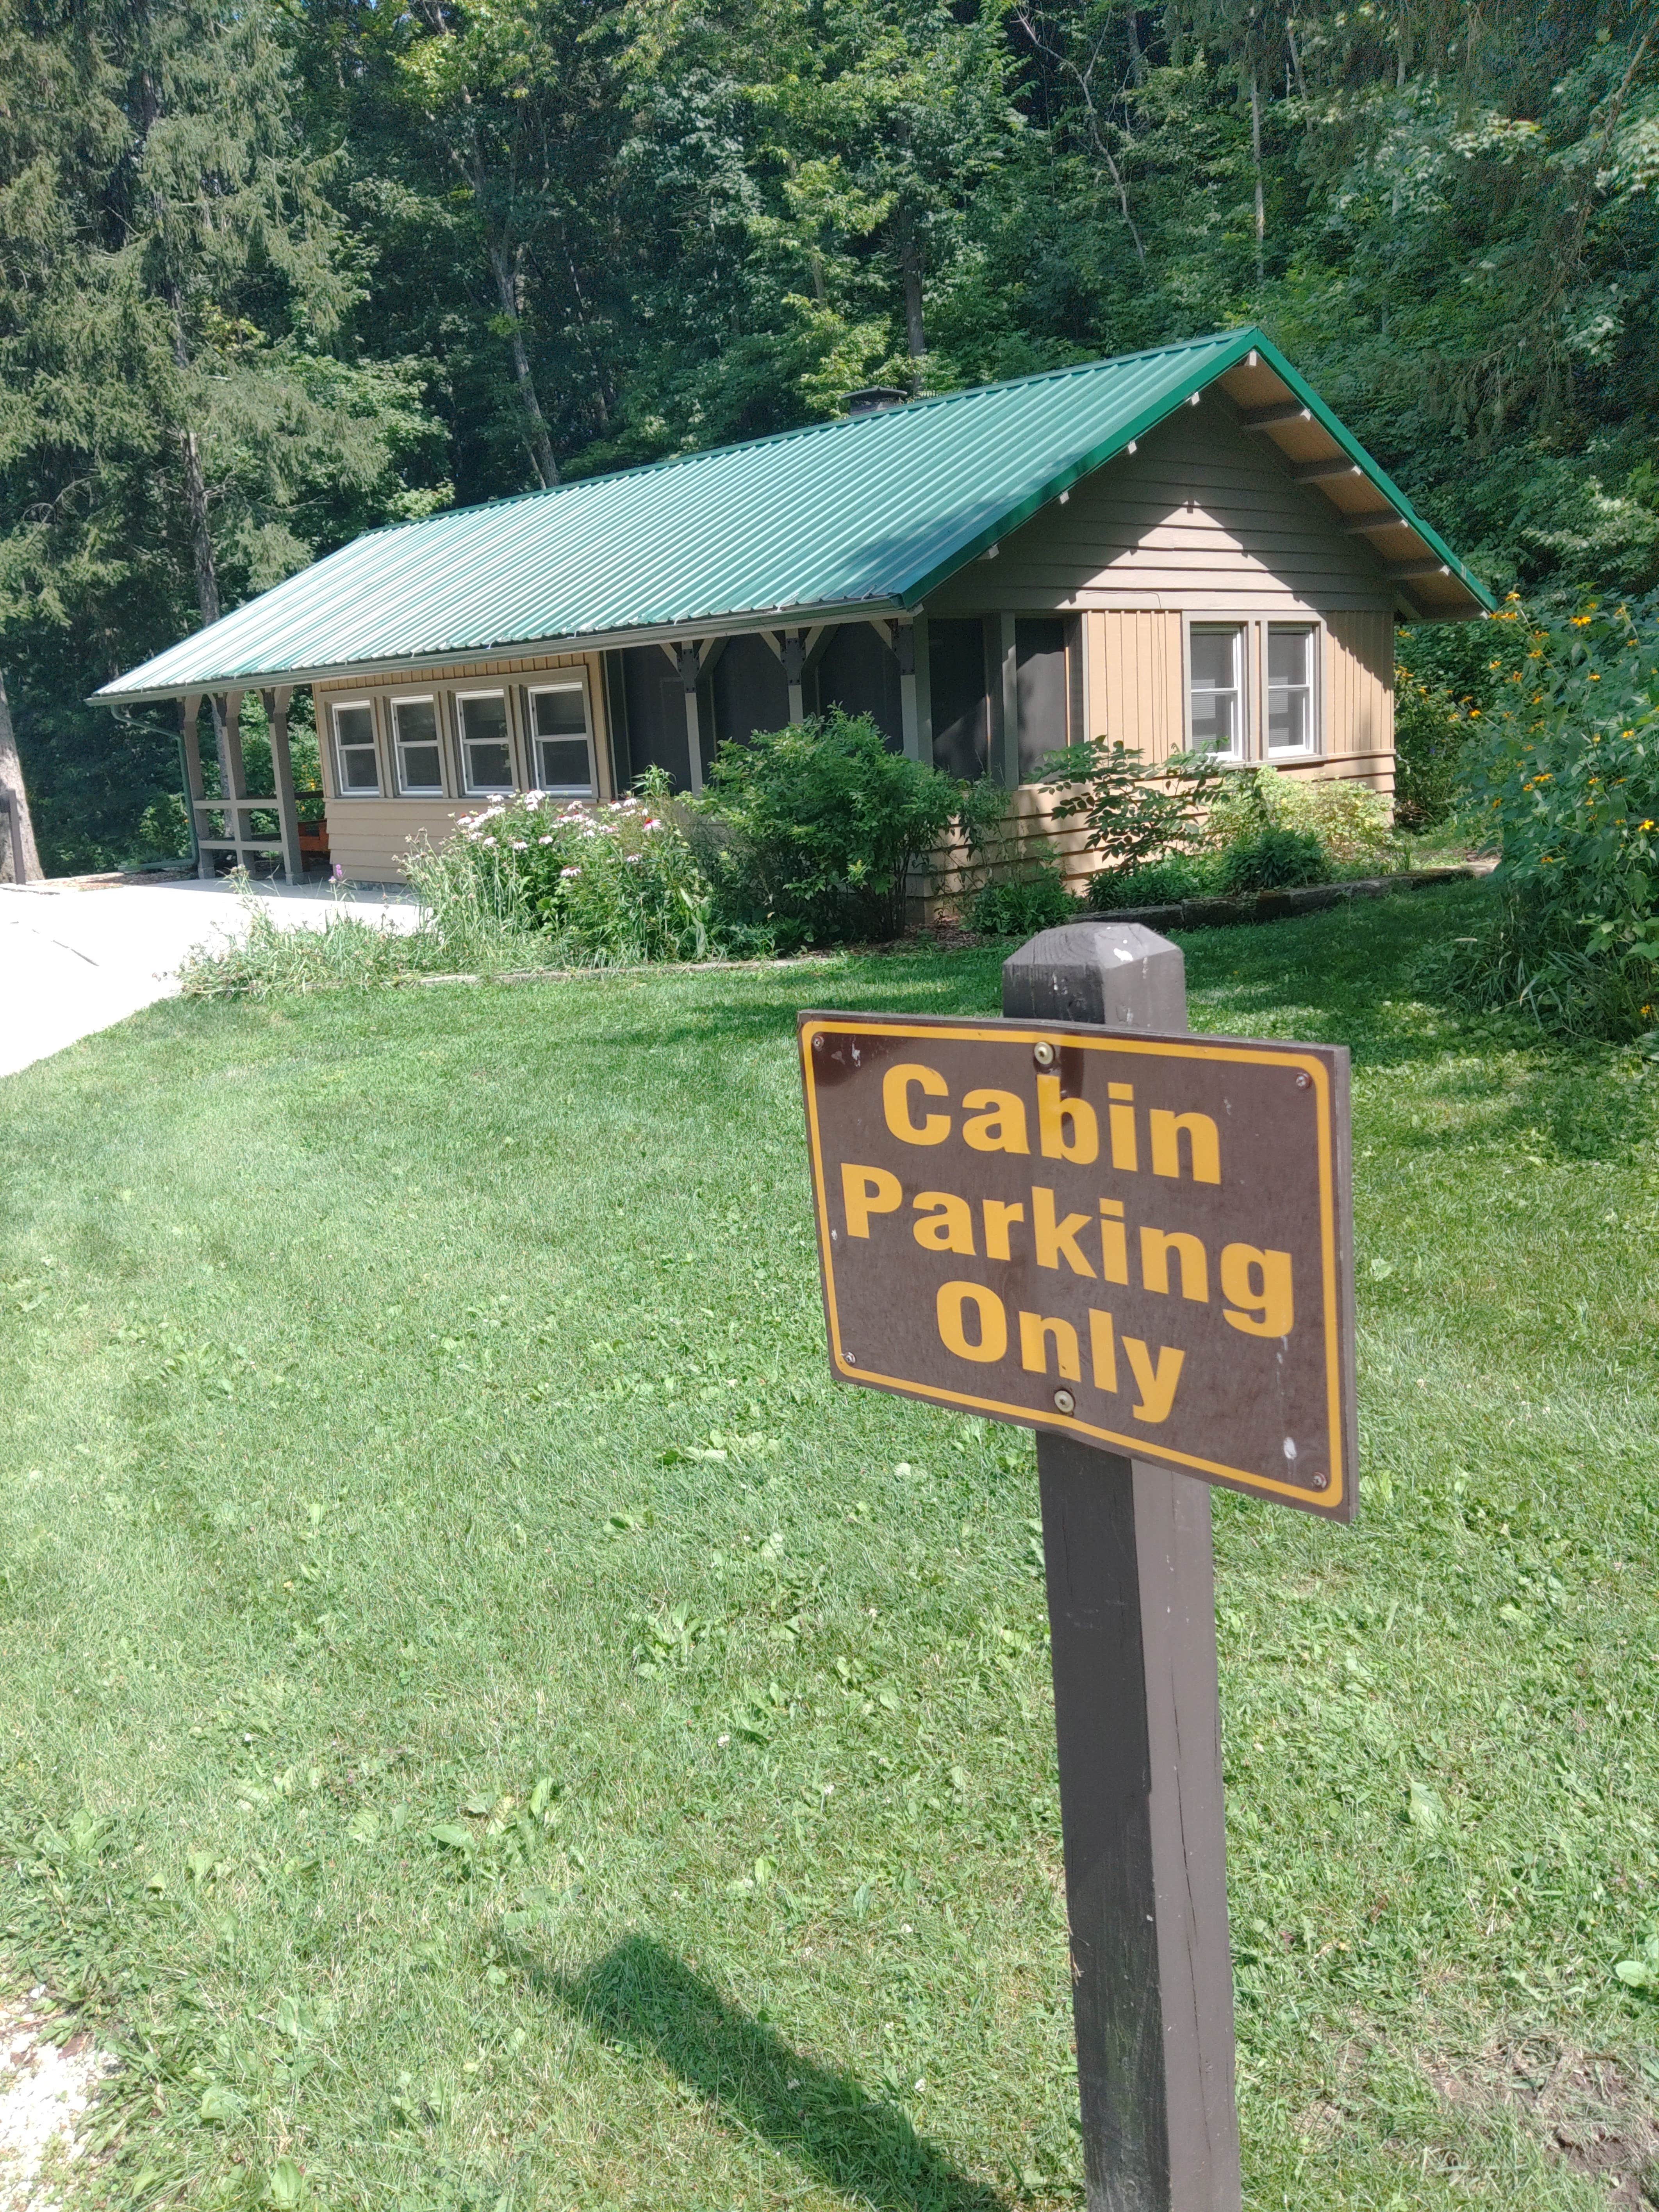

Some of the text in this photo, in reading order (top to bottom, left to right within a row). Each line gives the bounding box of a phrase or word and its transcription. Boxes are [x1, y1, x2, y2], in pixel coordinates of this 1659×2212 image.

[882, 1063, 1222, 1185] Cabin
[840, 1162, 1295, 1339] Parking
[936, 1281, 1186, 1424] Only
